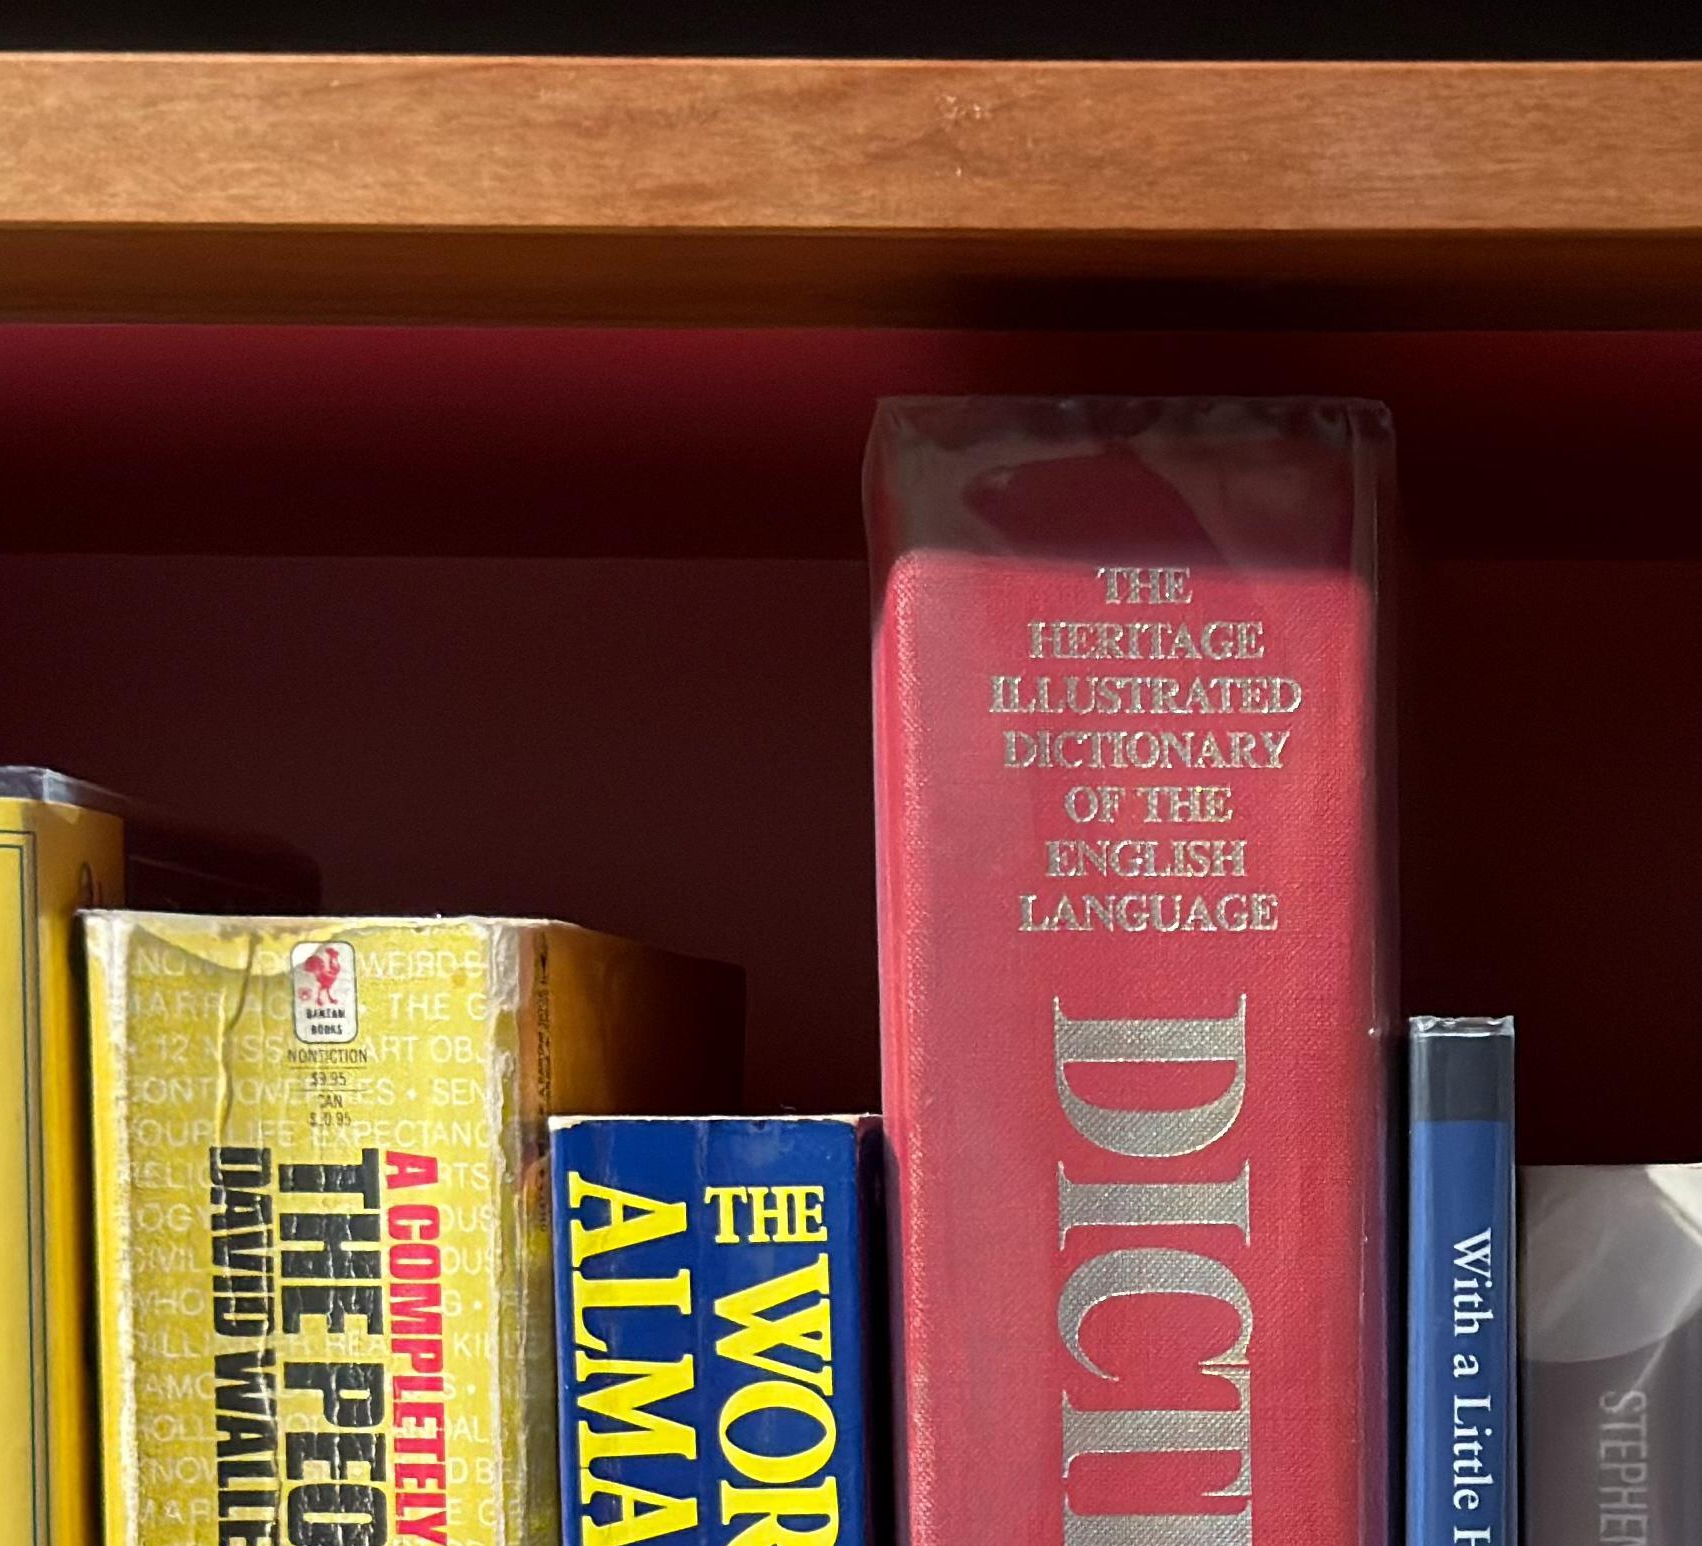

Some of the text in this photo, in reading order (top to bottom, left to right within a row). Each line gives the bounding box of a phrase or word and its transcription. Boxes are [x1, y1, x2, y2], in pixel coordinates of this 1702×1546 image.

[1097, 566, 1193, 605] THE
[1027, 621, 1264, 659] HERITAGE
[989, 675, 1302, 714] ILLUSTRATED
[1002, 730, 1290, 769] DICTIONARY
[1063, 785, 1233, 824] OF THE
[1045, 840, 1247, 878] ENGLISH
[1018, 894, 1278, 932] LANGUAGE
[386, 1151, 438, 1189] A
[704, 1185, 828, 1244] THE
[209, 1147, 275, 1337] DAVID
[278, 1147, 382, 1335] THE
[1452, 1227, 1494, 1338] With
[388, 1204, 447, 1546] COMPLETELY
[1453, 1352, 1478, 1378] a
[1452, 1394, 1491, 1511] Little
